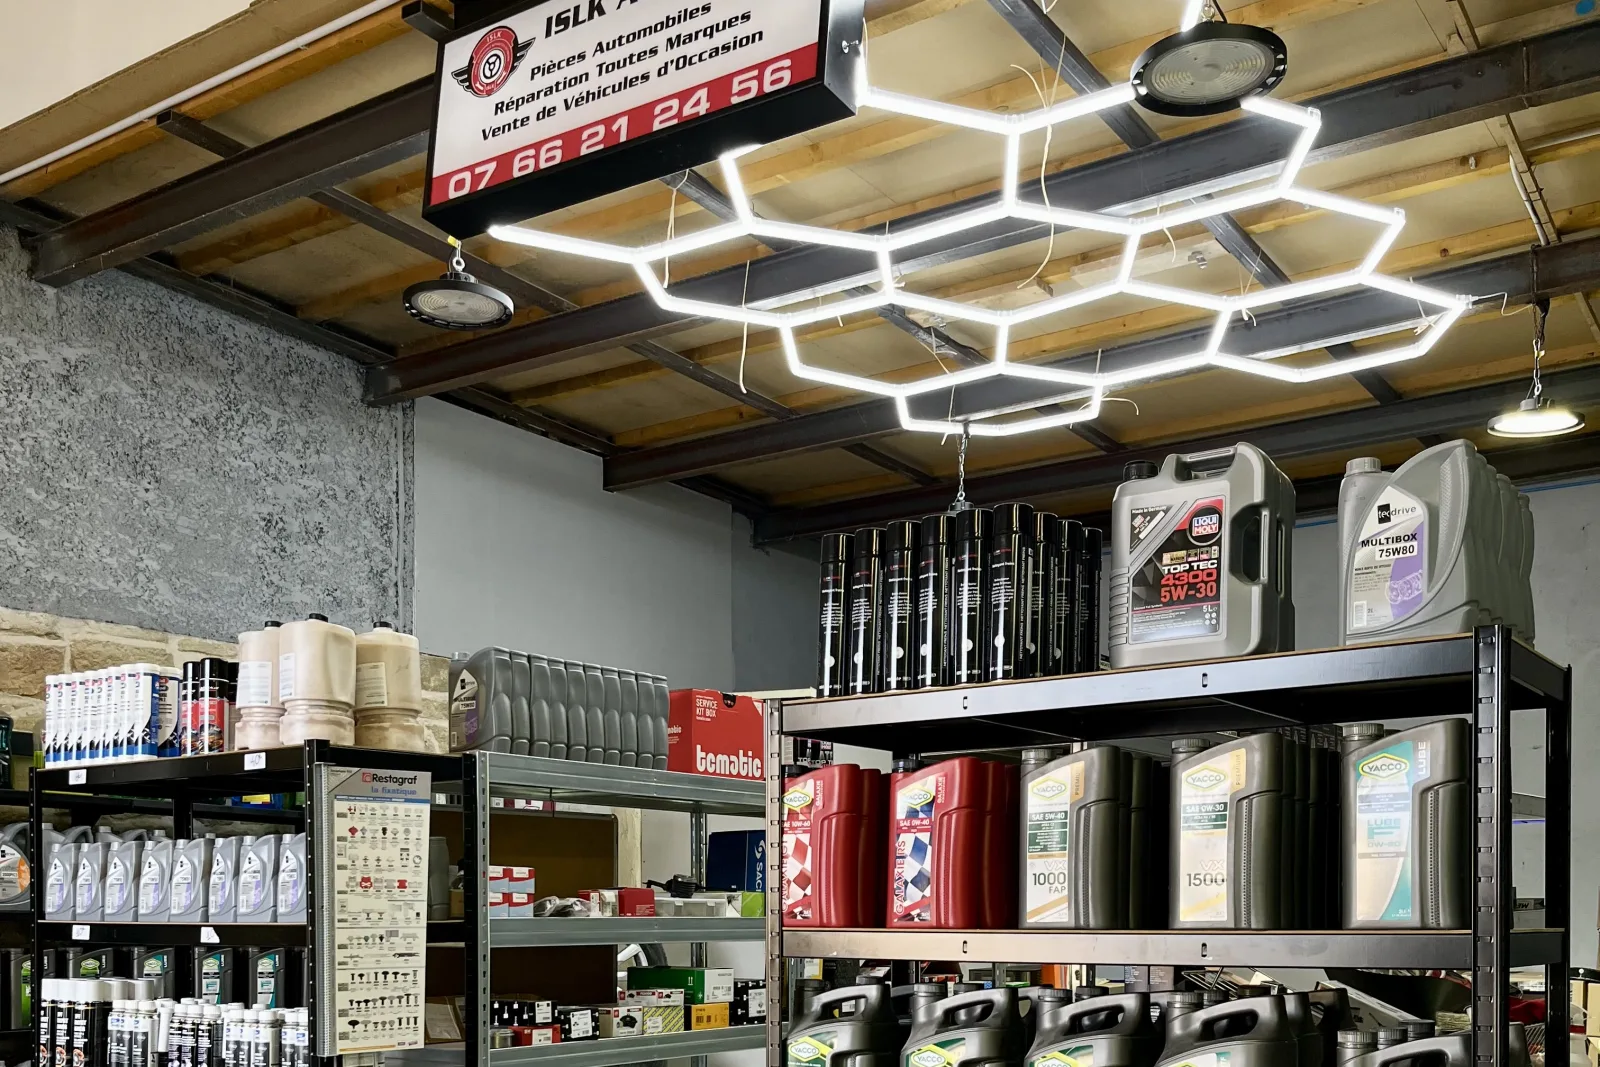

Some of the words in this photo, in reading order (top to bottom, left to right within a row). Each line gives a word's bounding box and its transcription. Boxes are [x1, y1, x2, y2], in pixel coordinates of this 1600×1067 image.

[545, 0, 606, 39] ISLK
[486, 30, 503, 42] ISLK
[530, 50, 587, 81] Pièces
[592, 2, 712, 57] Automobiles
[494, 71, 589, 116] Réparation
[596, 45, 658, 78] Toutes
[665, 10, 751, 53] Marques
[481, 115, 530, 141] Vente
[536, 104, 557, 122] de
[563, 70, 650, 111] Véhicules
[657, 30, 764, 78] d'Occasion
[447, 160, 498, 199] 07
[512, 139, 563, 179] 66
[580, 115, 629, 157] 21
[652, 87, 711, 131] 24
[730, 58, 792, 105] 56
[1194, 515, 1218, 526] LIQUI
[1194, 524, 1216, 536] MOLY
[1361, 532, 1418, 548] MULTIBOX
[1379, 544, 1415, 558] 75W80
[1162, 564, 1190, 574] TOP
[1192, 560, 1218, 570] TEC
[1160, 568, 1217, 586] 4300
[1160, 582, 1216, 602] 5W-30
[696, 698, 718, 709] SERVICE
[706, 709, 716, 718] BOX
[696, 744, 762, 778] tcmatic
[1418, 742, 1426, 774] LUBE
[1368, 762, 1402, 772] YACCO
[372, 774, 418, 786] Restagraf
[1190, 774, 1222, 783] YACCO
[1036, 785, 1063, 793] YACCO
[1201, 804, 1224, 812] 0W-30
[898, 840, 906, 856] RS
[1044, 860, 1067, 871] VX
[1032, 872, 1066, 886] 1000
[1186, 872, 1225, 886] 1500
[896, 859, 905, 914] GALAXIE
[1049, 886, 1066, 894] FAP
[794, 1046, 817, 1054] YACCO
